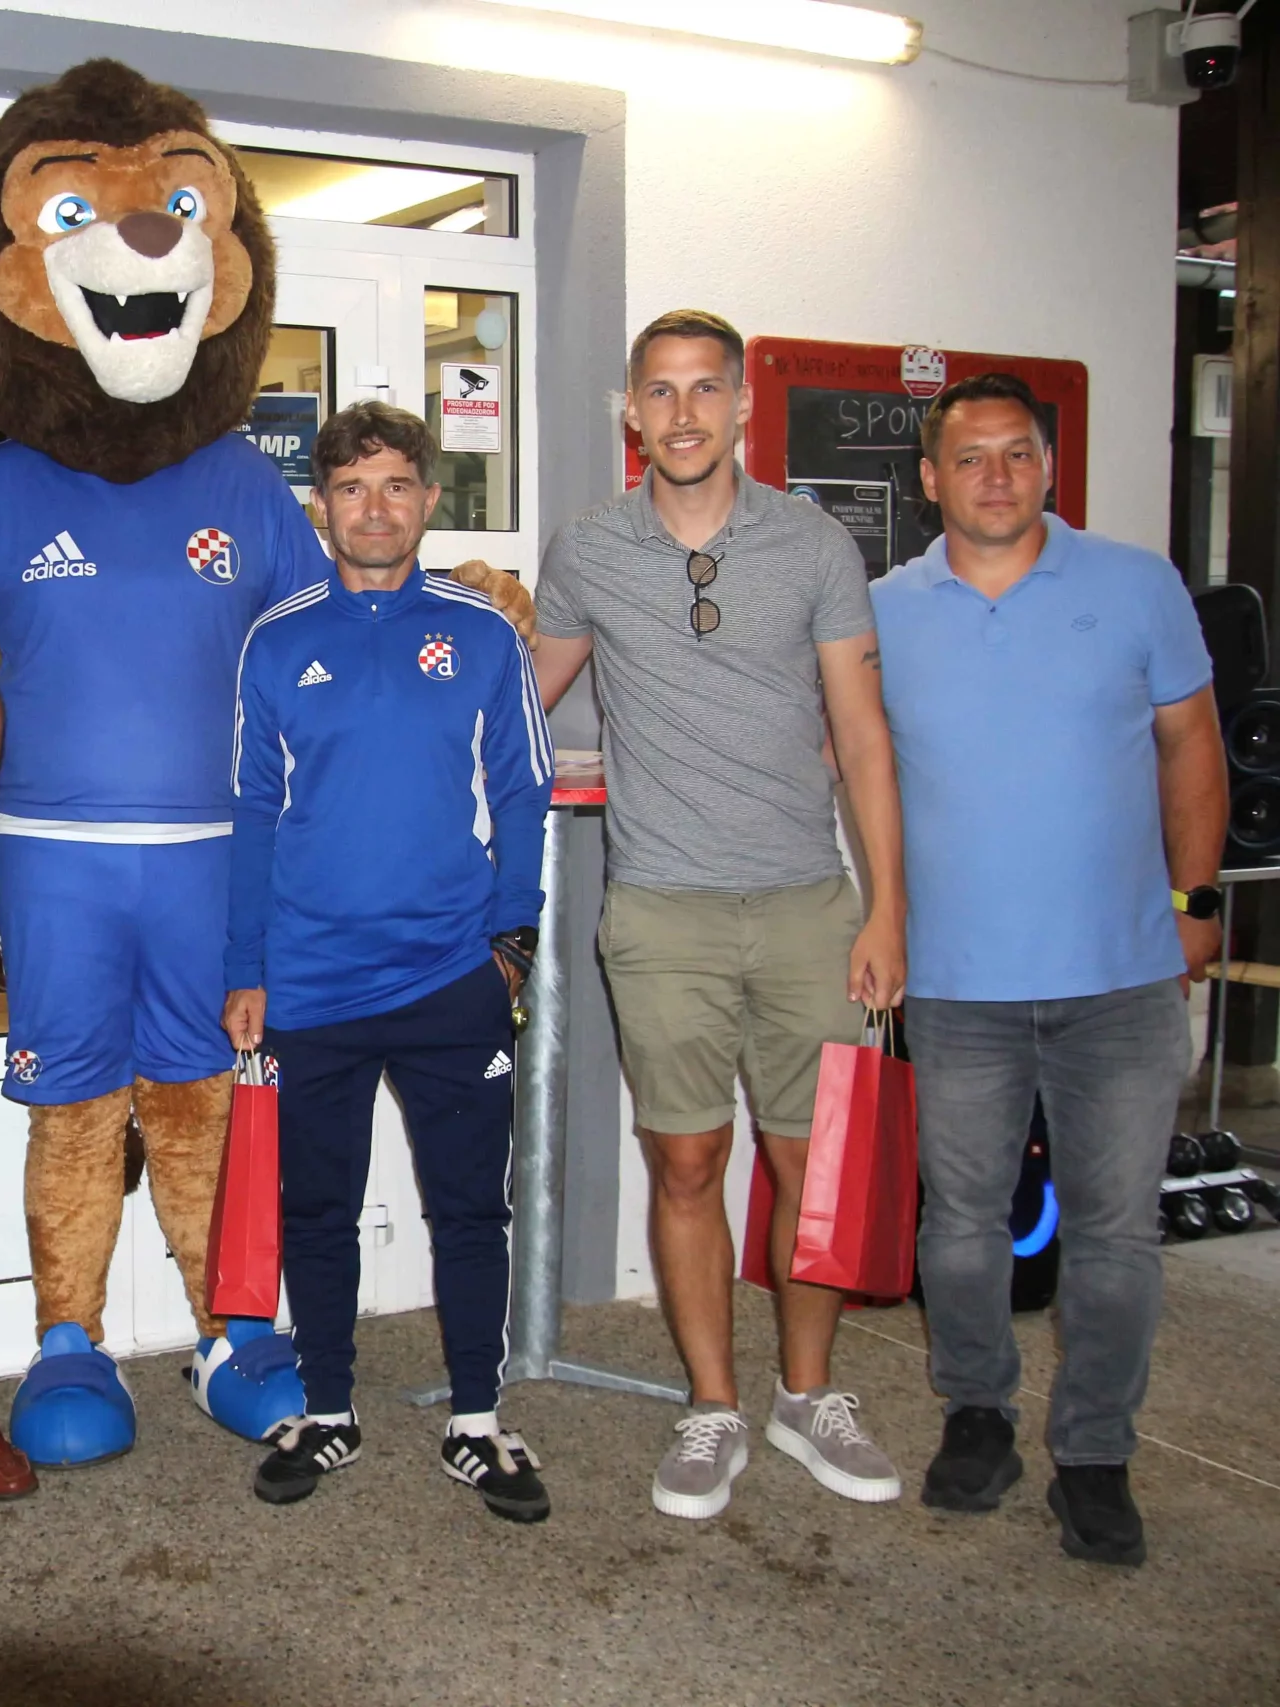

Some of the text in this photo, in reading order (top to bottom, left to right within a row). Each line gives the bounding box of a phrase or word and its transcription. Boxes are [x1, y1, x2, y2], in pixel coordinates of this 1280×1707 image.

[446, 400, 473, 408] PROSTOR
[22, 560, 97, 582] adidas
[297, 673, 332, 687] adidas
[484, 1063, 512, 1079] adida
